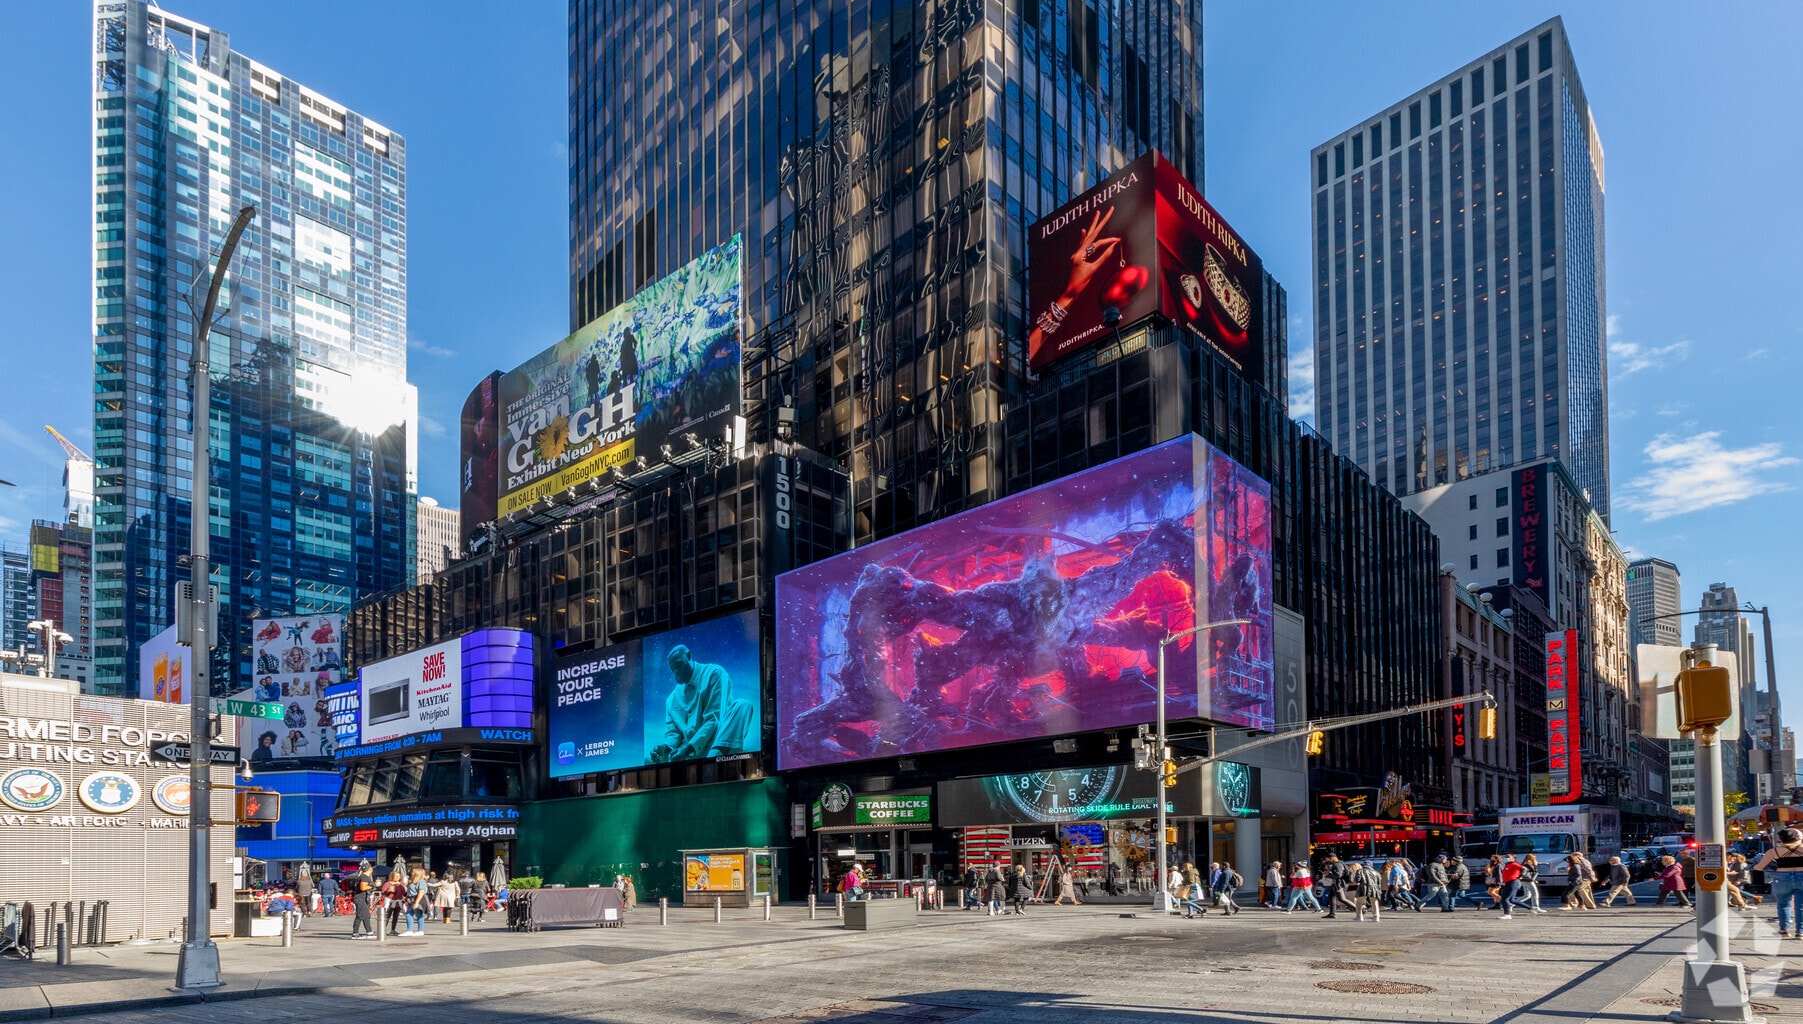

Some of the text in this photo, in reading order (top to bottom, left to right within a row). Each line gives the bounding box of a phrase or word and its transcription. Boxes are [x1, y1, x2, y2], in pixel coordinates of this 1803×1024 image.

[1041, 171, 1138, 239] JUDITH RIPKA
[1177, 182, 1248, 267] JUDITH RIPKA
[507, 374, 570, 413] THE ORIGINAL
[507, 384, 570, 424] Immersive
[709, 404, 731, 418] Canada
[507, 457, 557, 490] Exhibit
[560, 441, 594, 466] New
[597, 420, 636, 447] York
[507, 447, 630, 511] ON SALE NOW VanGoghNYC.com
[778, 456, 790, 530] 1500
[1519, 468, 1541, 573] BREWERY
[423, 651, 445, 669] SAVE
[558, 655, 625, 681] INCREASE
[1547, 640, 1563, 690] PARK
[422, 664, 446, 683] NOW!
[416, 682, 452, 696] KitchenAid
[558, 676, 593, 694] YOUR
[558, 688, 601, 707] PEACE
[231, 702, 281, 717] W 43 St
[419, 705, 450, 723] Whirlpool
[164, 747, 190, 757] ONE
[344, 743, 383, 758] MORNINGS
[385, 740, 401, 752] FROM
[422, 732, 442, 744] 7AM
[480, 729, 532, 741] WATCH
[585, 740, 615, 750] LEBRON
[1549, 719, 1566, 769] PARK
[558, 749, 575, 759] Calm
[585, 748, 610, 758] JAMES
[1021, 774, 1090, 789] 8 4
[1068, 789, 1077, 801] 5
[857, 800, 928, 809] STARBUCKS
[1049, 805, 1085, 814] ROTATING
[1132, 802, 1150, 810] DIAL
[50, 816, 76, 827] AIR
[336, 817, 353, 827] NASA:
[354, 816, 373, 826] Space
[374, 814, 397, 824] station
[398, 812, 432, 822] remains
[435, 811, 446, 820] at
[448, 809, 475, 822] high
[479, 808, 504, 819] risk
[869, 810, 914, 819] COFFEE
[1511, 815, 1575, 825] AMERICAN
[339, 832, 350, 842] MVP
[353, 829, 379, 842] ESPN
[382, 828, 428, 840] Kardashian
[431, 826, 463, 839] helps
[466, 825, 515, 837] Afghan
[1004, 837, 1046, 846] CITIZEN
